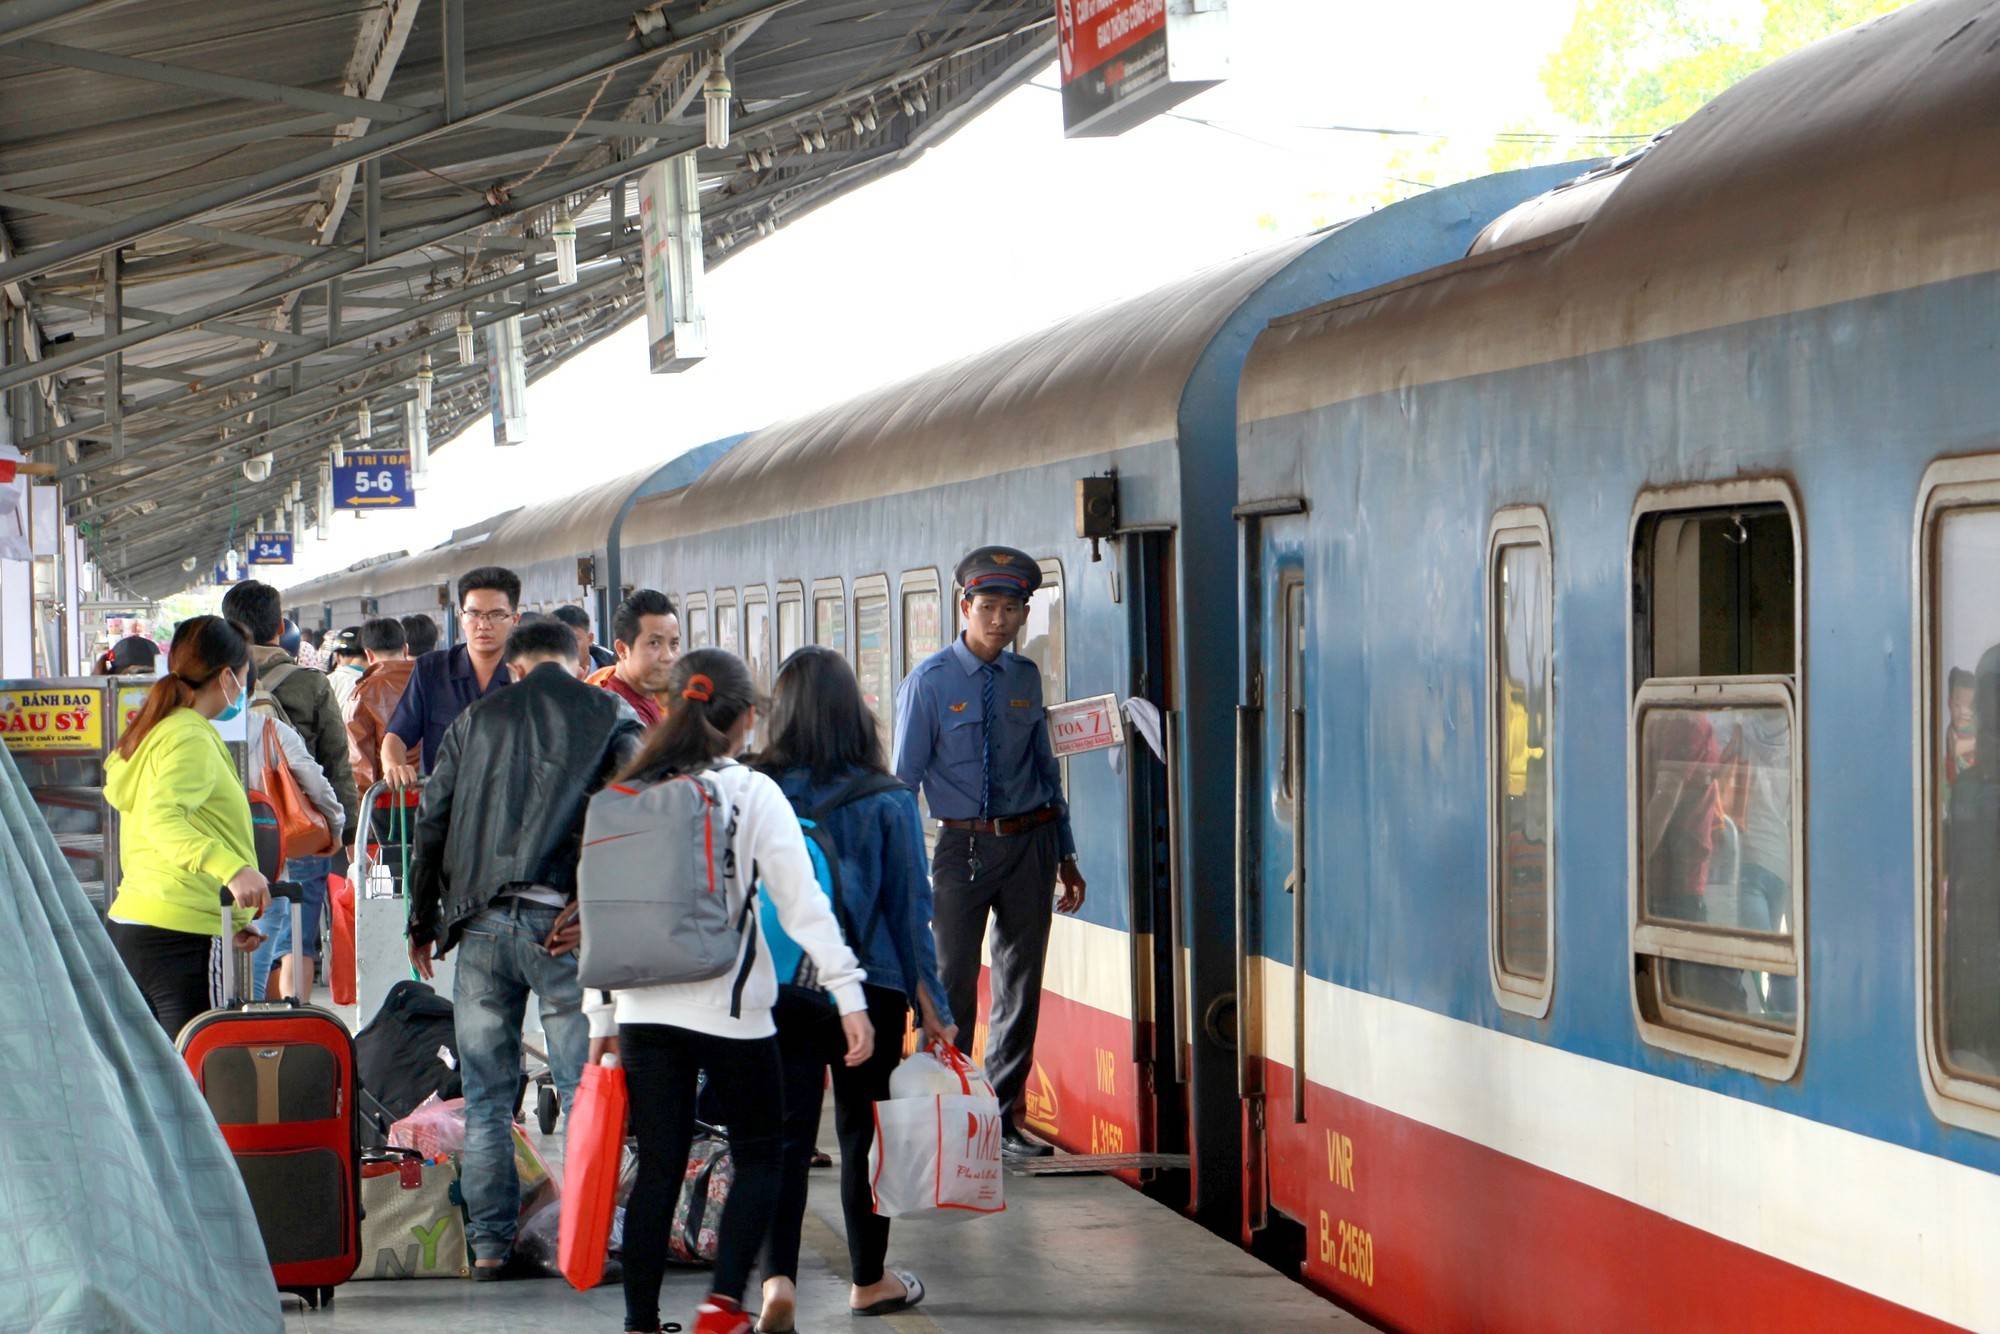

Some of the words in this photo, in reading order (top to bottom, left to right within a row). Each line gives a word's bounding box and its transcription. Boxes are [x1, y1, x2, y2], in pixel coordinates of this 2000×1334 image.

[355, 470, 393, 493] 5-6
[259, 543, 282, 556] 3-4
[21, 692, 59, 707] BÁNH
[63, 694, 91, 705] BAO
[1055, 720, 1084, 737] TOA
[1087, 710, 1102, 734] 7
[1095, 1047, 1115, 1096] VNR
[1326, 1128, 1354, 1192] VNR
[1338, 1218, 1374, 1288] 21560
